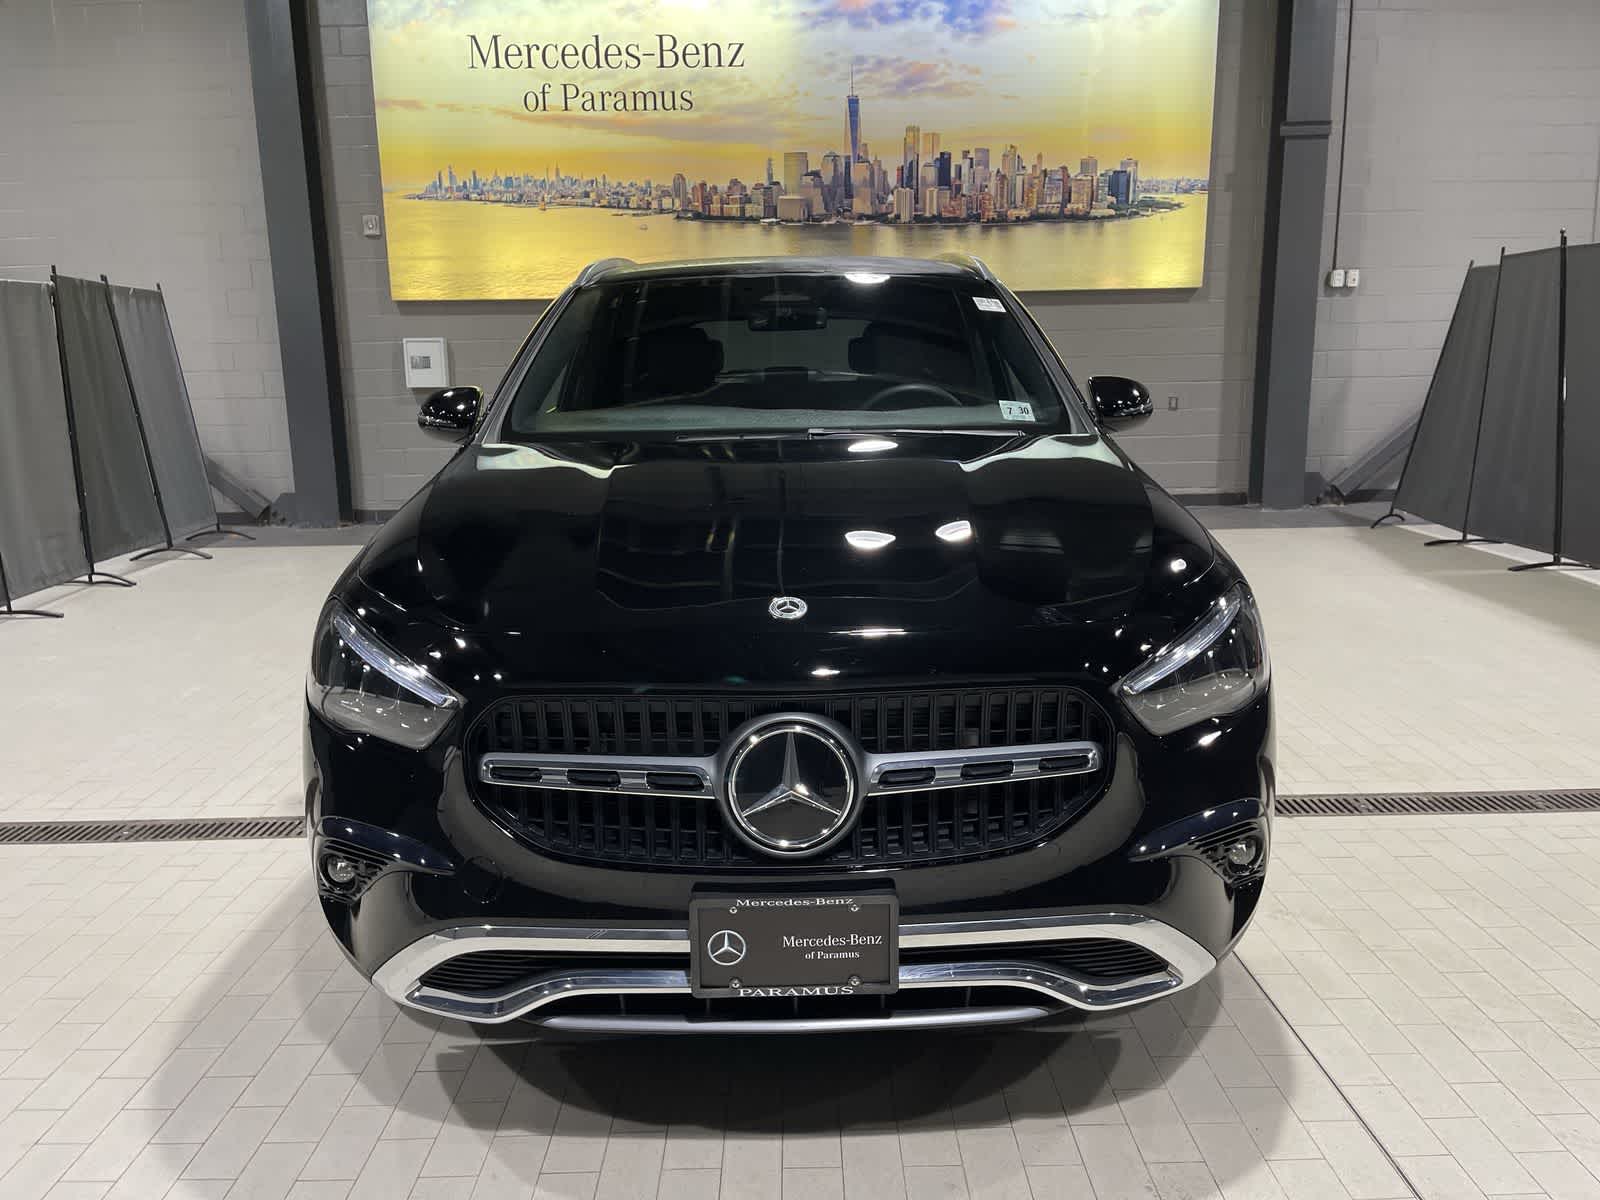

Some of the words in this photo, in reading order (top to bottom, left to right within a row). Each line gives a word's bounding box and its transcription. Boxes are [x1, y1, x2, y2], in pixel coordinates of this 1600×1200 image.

[467, 33, 745, 70] Mercedes-Benz
[523, 82, 551, 112] of
[560, 83, 694, 112] Paramus
[1007, 407, 1013, 415] 7
[735, 898, 854, 907] Mercedes-Benz
[782, 933, 883, 948] Mercedes-Benz
[804, 950, 815, 960] of
[817, 950, 860, 960] Paramus
[739, 986, 854, 997] PARAMUS
